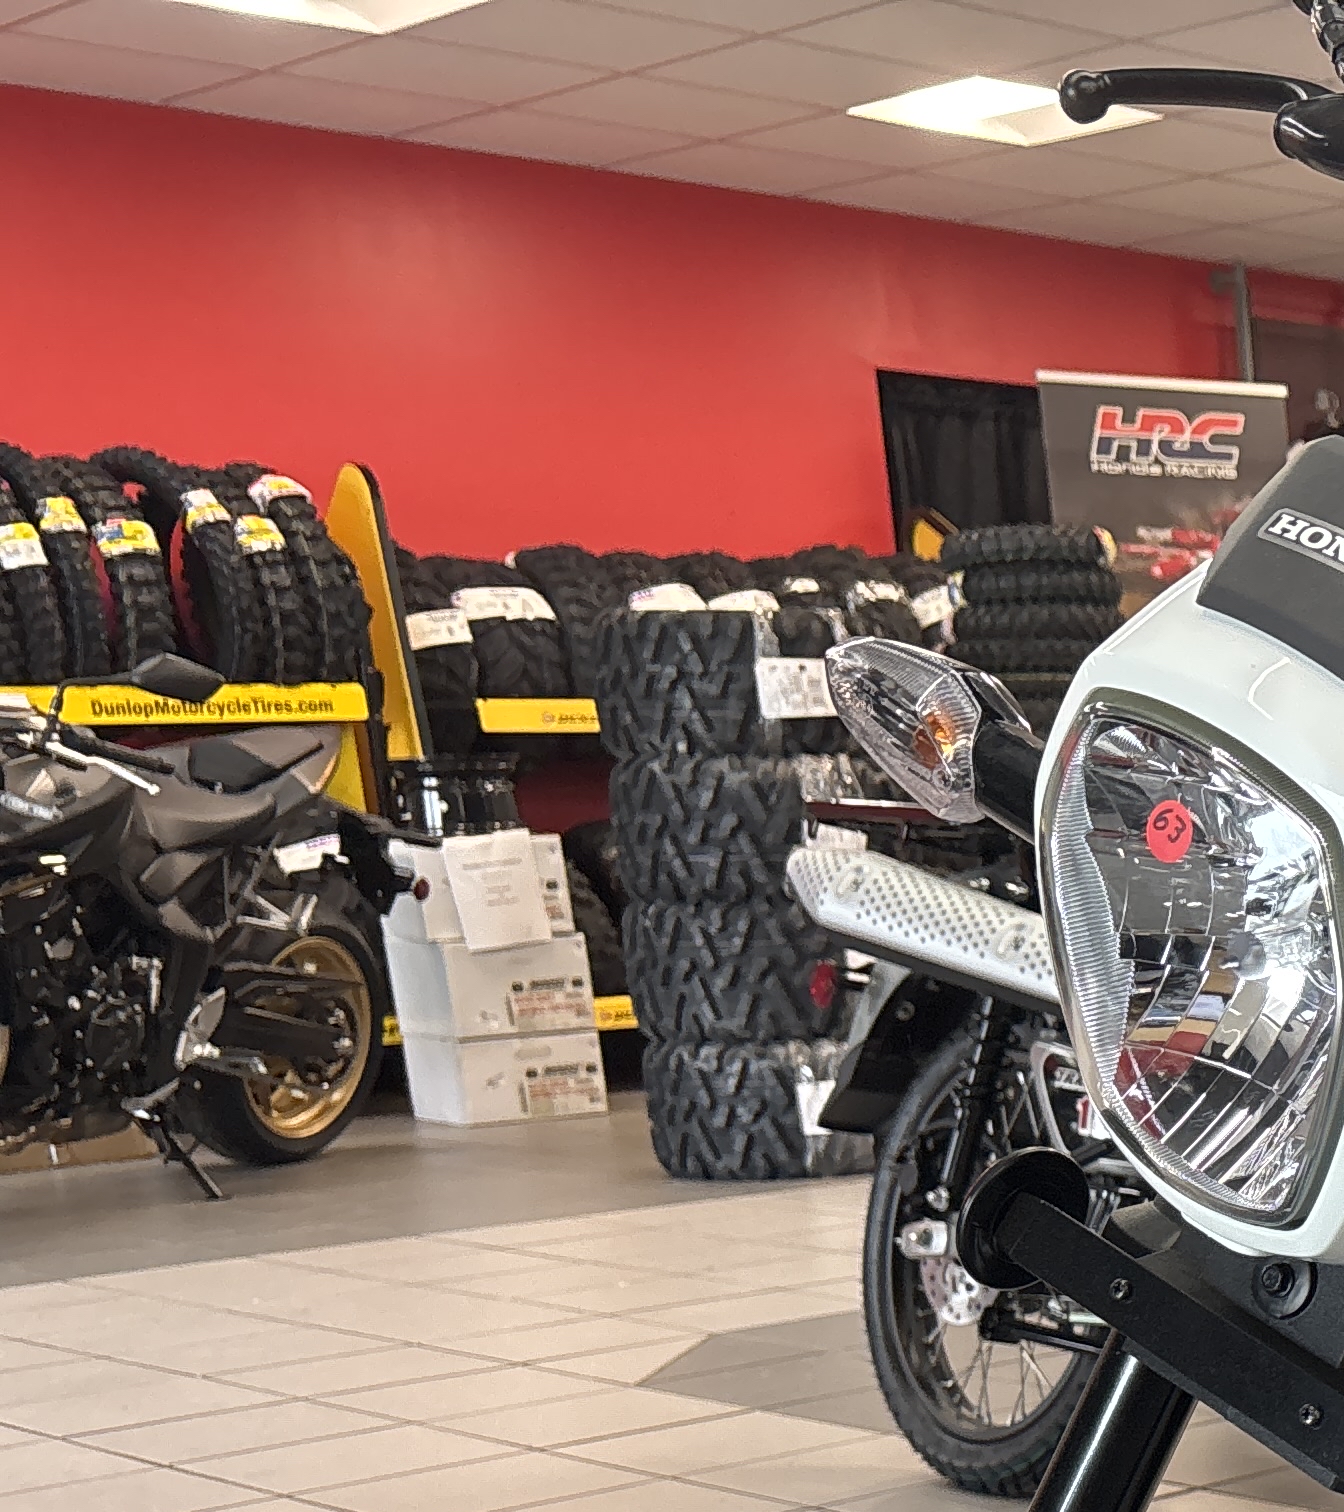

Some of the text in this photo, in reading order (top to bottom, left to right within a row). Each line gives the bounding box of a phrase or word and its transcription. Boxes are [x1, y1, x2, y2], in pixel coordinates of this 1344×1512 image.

[1091, 405, 1245, 464] HRC
[91, 695, 335, 720] DunlopMotorcycleTires.com
[1152, 807, 1187, 844] 63
